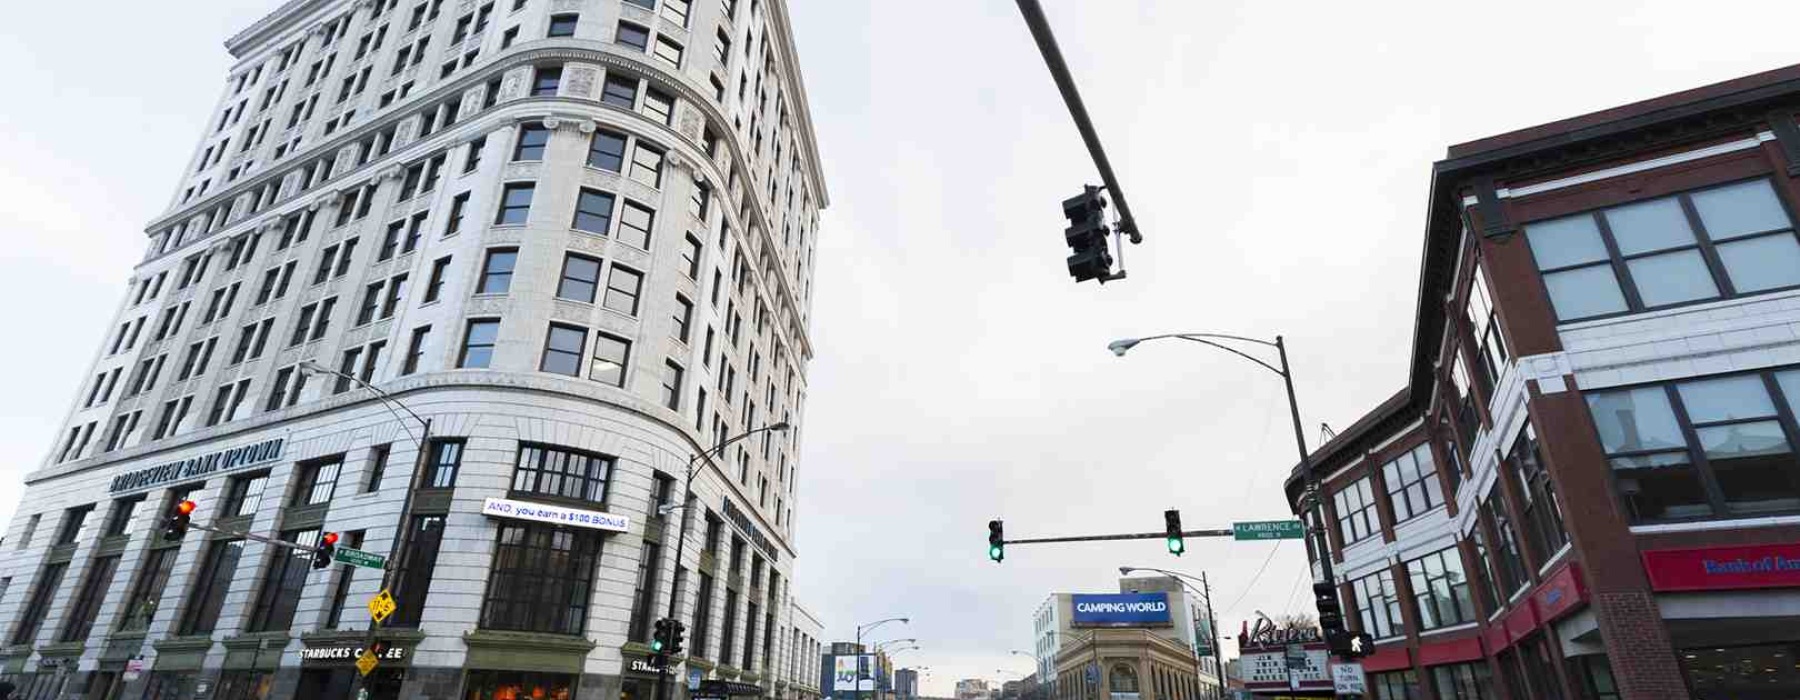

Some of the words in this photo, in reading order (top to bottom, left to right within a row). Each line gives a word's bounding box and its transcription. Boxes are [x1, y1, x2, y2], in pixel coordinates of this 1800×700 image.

[182, 451, 223, 478] BANK
[222, 438, 284, 470] UPTOWN
[515, 507, 535, 516] you
[537, 510, 559, 519] earn
[568, 513, 590, 523] $100
[592, 516, 626, 528] BONUS
[1242, 522, 1291, 532] LAWRENCE
[1704, 559, 1749, 573] Bank
[1077, 603, 1125, 612] CAMPING
[1125, 602, 1166, 612] WORLD
[299, 647, 352, 659] STARBUCKS
[354, 647, 403, 659] CEE
